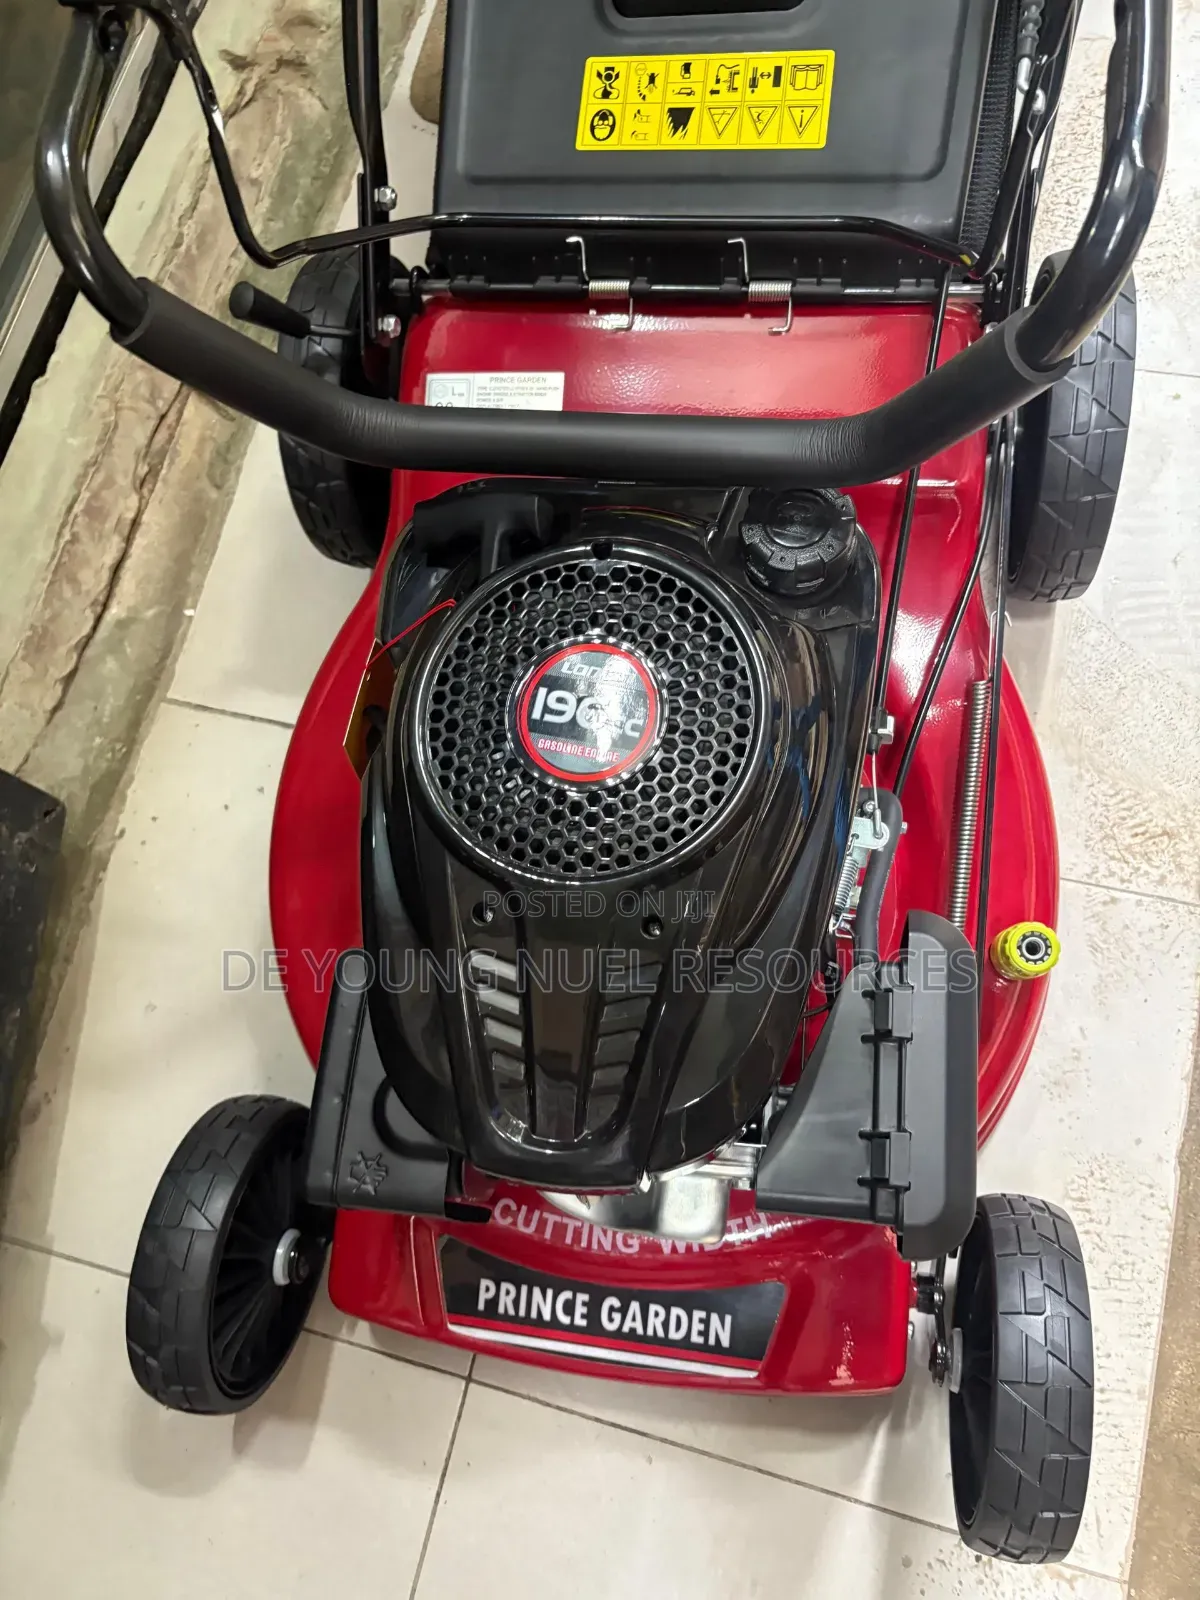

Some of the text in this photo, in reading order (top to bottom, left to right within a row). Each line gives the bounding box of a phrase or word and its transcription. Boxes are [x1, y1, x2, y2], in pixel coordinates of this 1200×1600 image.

[489, 376, 547, 384] PRINCE GARDEN
[538, 738, 620, 762] GASOLINE ENNE
[494, 1198, 640, 1254] CUTTING
[476, 1277, 733, 1348] PRINCE GARDEN
